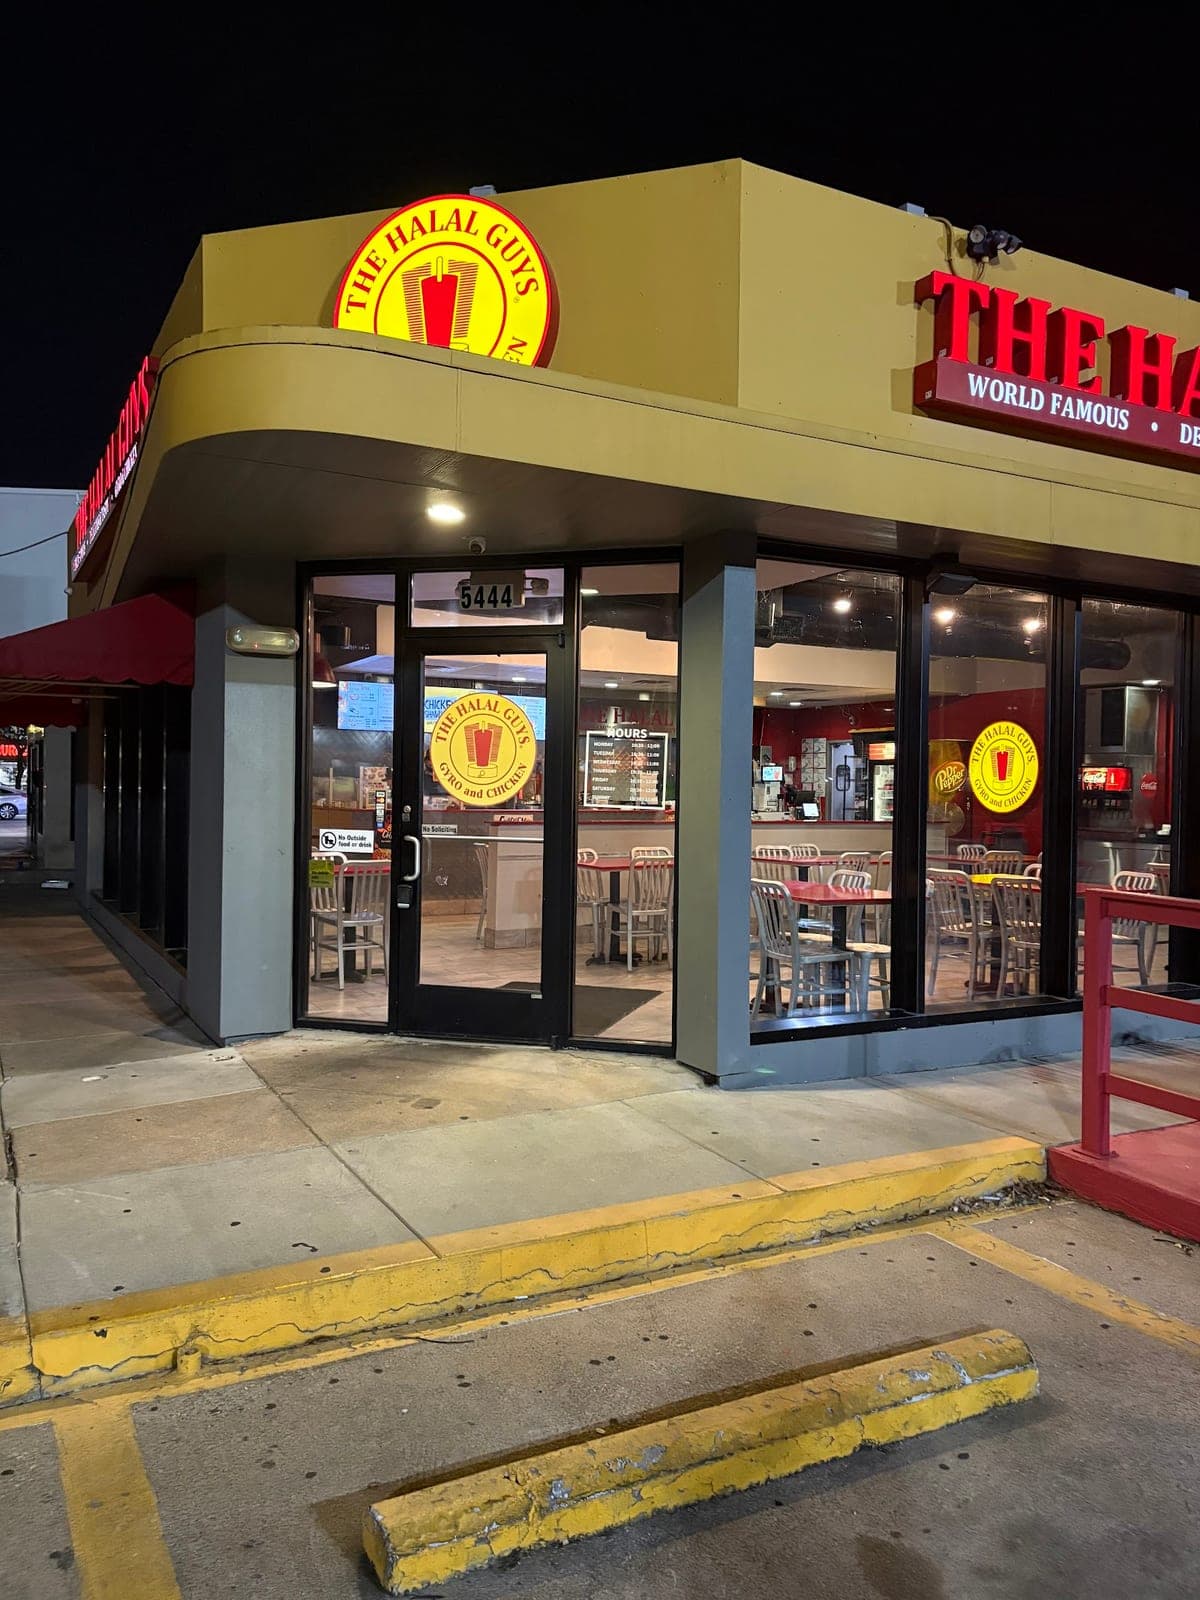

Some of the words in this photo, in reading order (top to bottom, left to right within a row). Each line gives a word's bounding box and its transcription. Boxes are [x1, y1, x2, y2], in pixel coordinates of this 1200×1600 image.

[345, 249, 387, 314] THE
[383, 208, 479, 254] HALAL
[486, 223, 539, 297] GUYS
[931, 270, 1105, 396] THE
[967, 372, 1045, 412] WORLD
[1050, 393, 1130, 430] FAMOUS
[460, 585, 513, 609] 5444
[435, 713, 457, 743] THE
[456, 698, 501, 718] HALAL
[503, 703, 531, 745] GUYS
[606, 728, 648, 739] HOURS
[972, 738, 987, 763] THE
[984, 724, 1016, 741] HALAL
[1017, 731, 1036, 764] GUYS
[439, 761, 463, 791] GYRO
[463, 786, 483, 799] and
[486, 762, 529, 798] CHICKEN
[935, 768, 965, 791] Pepper
[945, 766, 958, 778] Dr
[974, 778, 989, 803] GYRO
[989, 798, 1003, 808] and
[1003, 778, 1032, 807] CHICKEN
